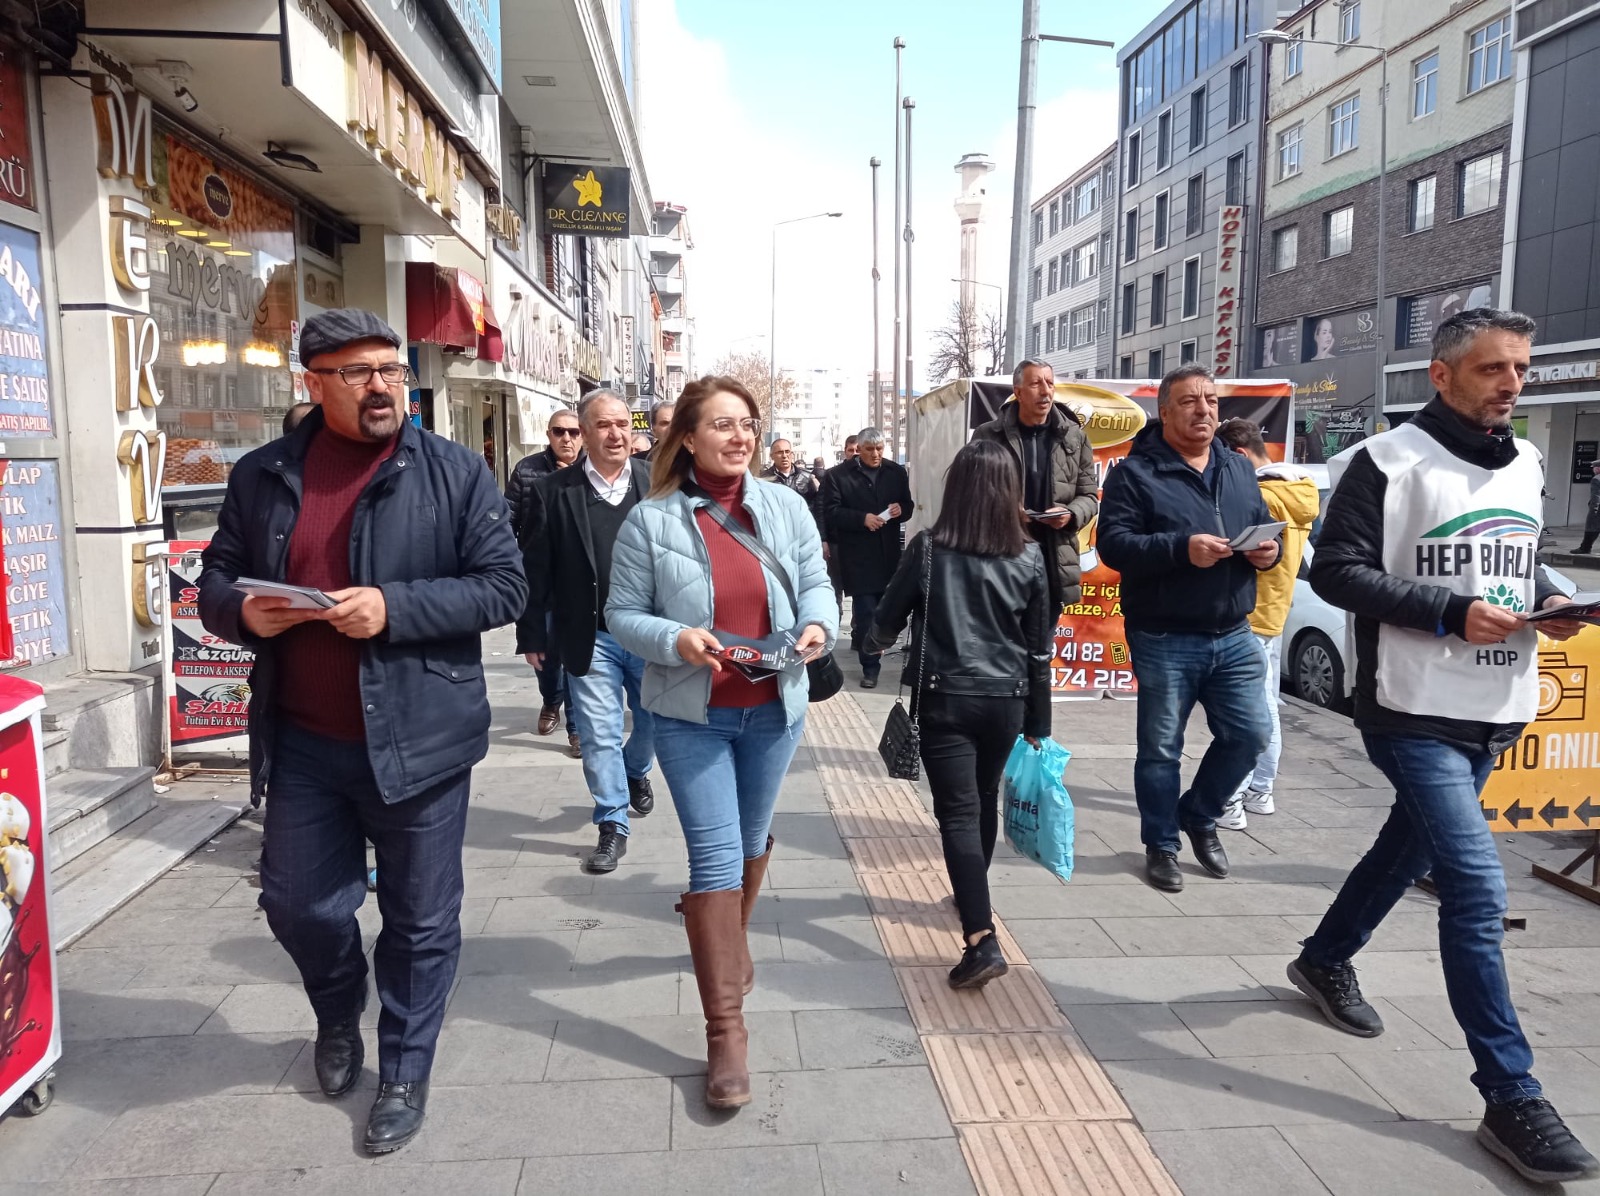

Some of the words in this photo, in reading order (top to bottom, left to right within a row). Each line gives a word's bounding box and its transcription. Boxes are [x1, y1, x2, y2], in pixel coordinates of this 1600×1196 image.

[344, 30, 465, 222] MERVE
[548, 209, 574, 223] DR
[1219, 207, 1241, 272] HOTEL
[0, 329, 43, 361] ATINA
[13, 376, 48, 411] SATIŞ
[1091, 412, 1132, 430] tatlı
[17, 523, 58, 544] MALZ.
[1416, 544, 1472, 577] HEP
[1081, 642, 1104, 662] 82
[1476, 650, 1518, 666] HDP
[181, 665, 213, 675] TELEFON
[216, 666, 224, 675] &
[1094, 669, 1133, 689] 212
[185, 716, 209, 725] Tütün
[211, 716, 224, 726] Evi
[225, 716, 232, 726] &
